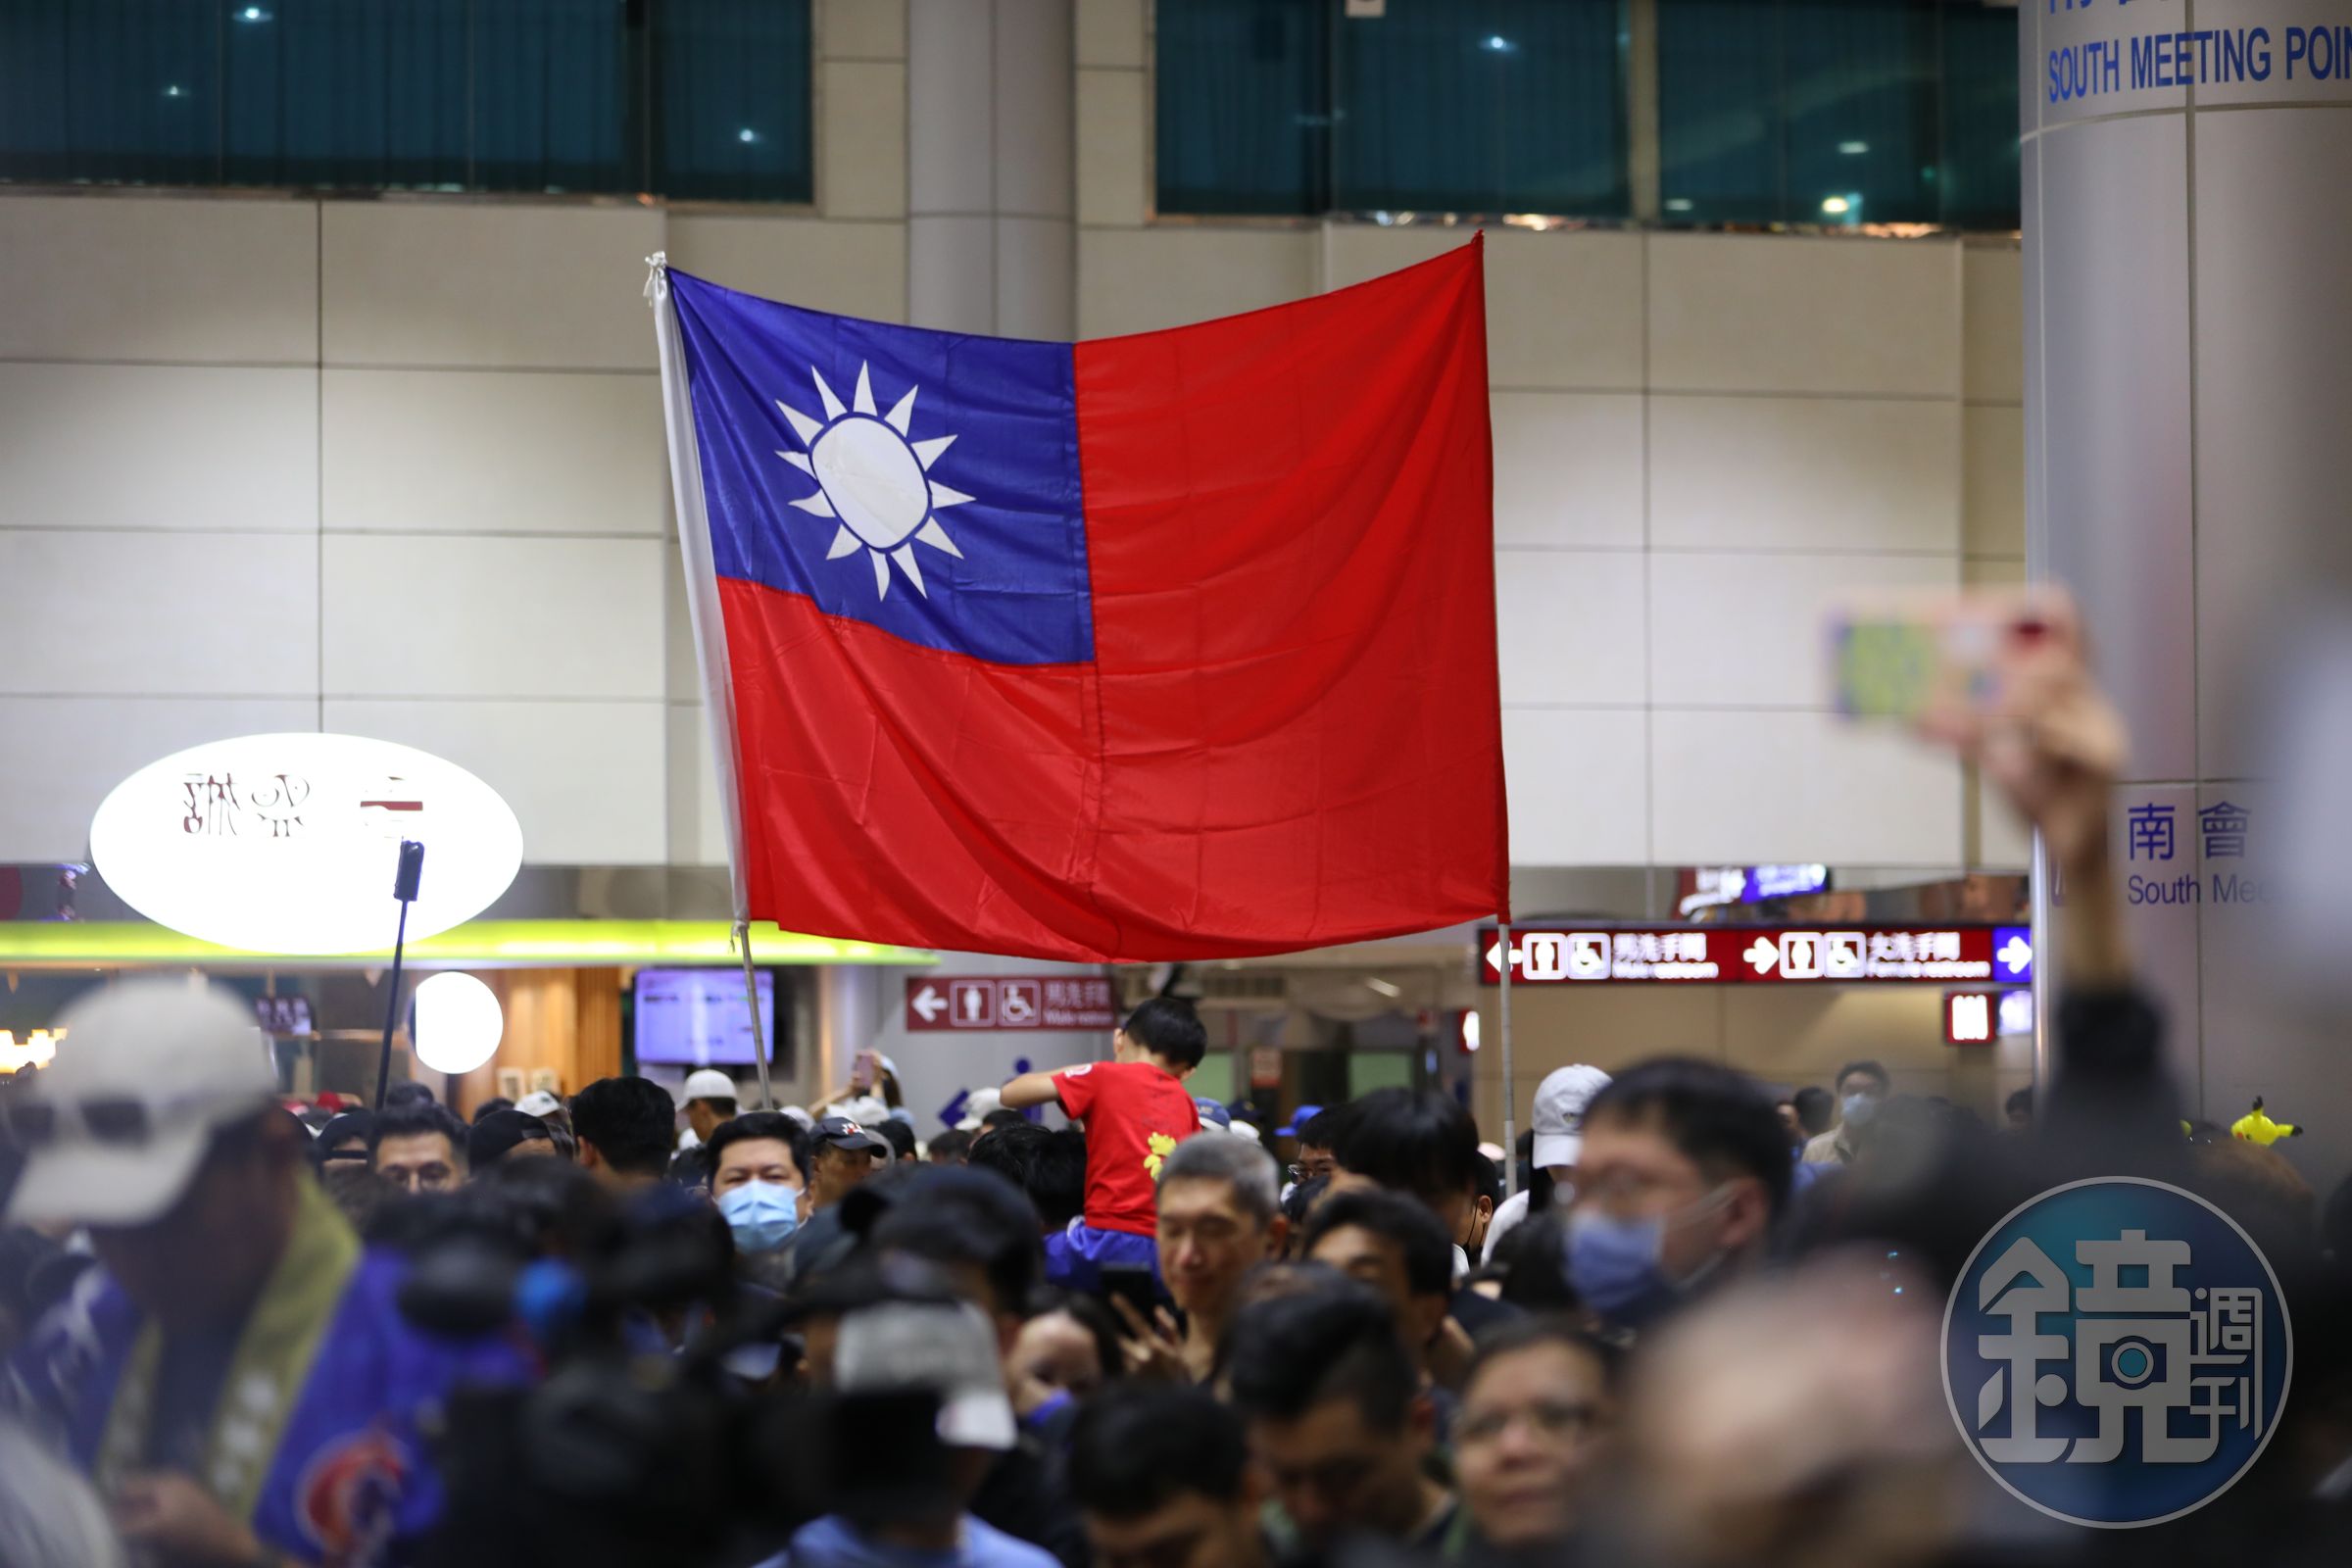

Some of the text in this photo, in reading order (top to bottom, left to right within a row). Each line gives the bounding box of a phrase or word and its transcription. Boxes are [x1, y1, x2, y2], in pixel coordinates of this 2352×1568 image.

[2048, 38, 2120, 104] SOUTH
[2131, 26, 2272, 90] MEETING
[2128, 875, 2201, 905] South
